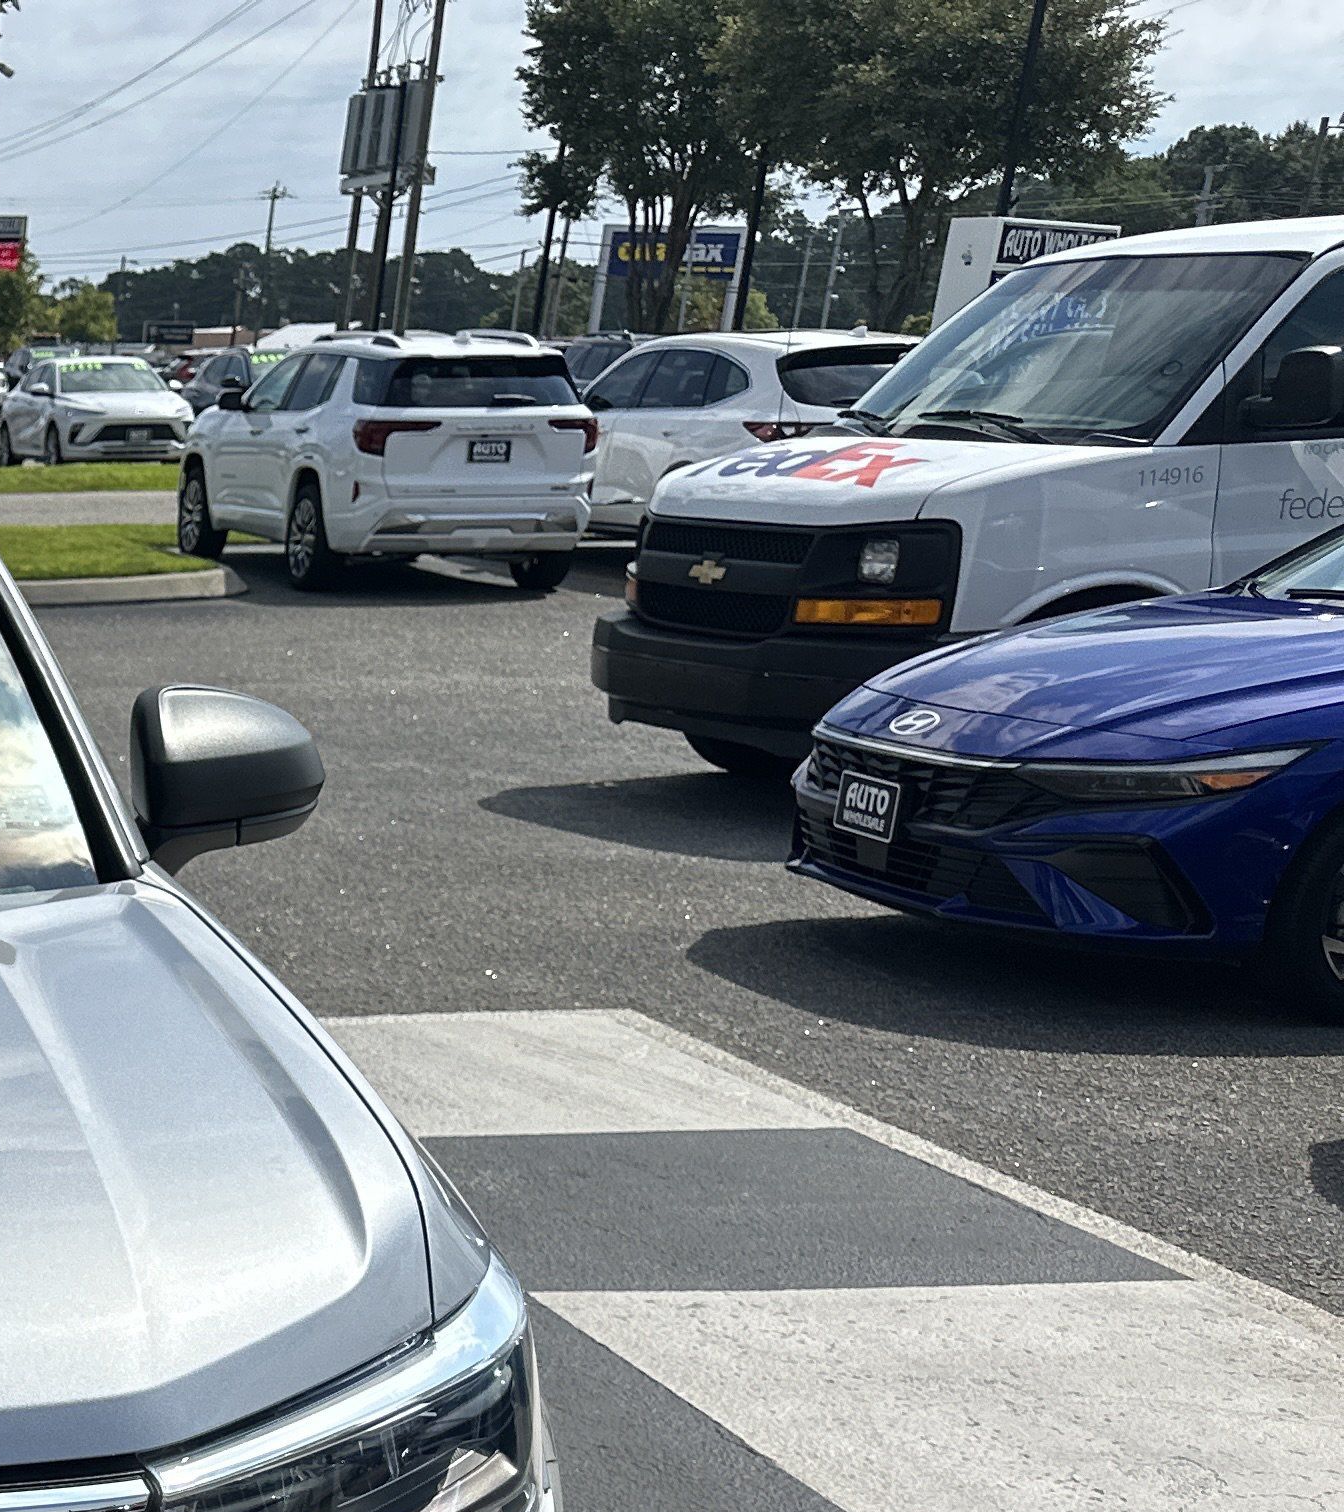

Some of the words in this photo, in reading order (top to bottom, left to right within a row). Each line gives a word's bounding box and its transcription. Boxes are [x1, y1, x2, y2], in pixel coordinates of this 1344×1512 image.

[618, 242, 724, 262] Carax
[1003, 229, 1042, 258] AUTO
[1138, 465, 1204, 487] 114916
[845, 782, 890, 815] AUTO
